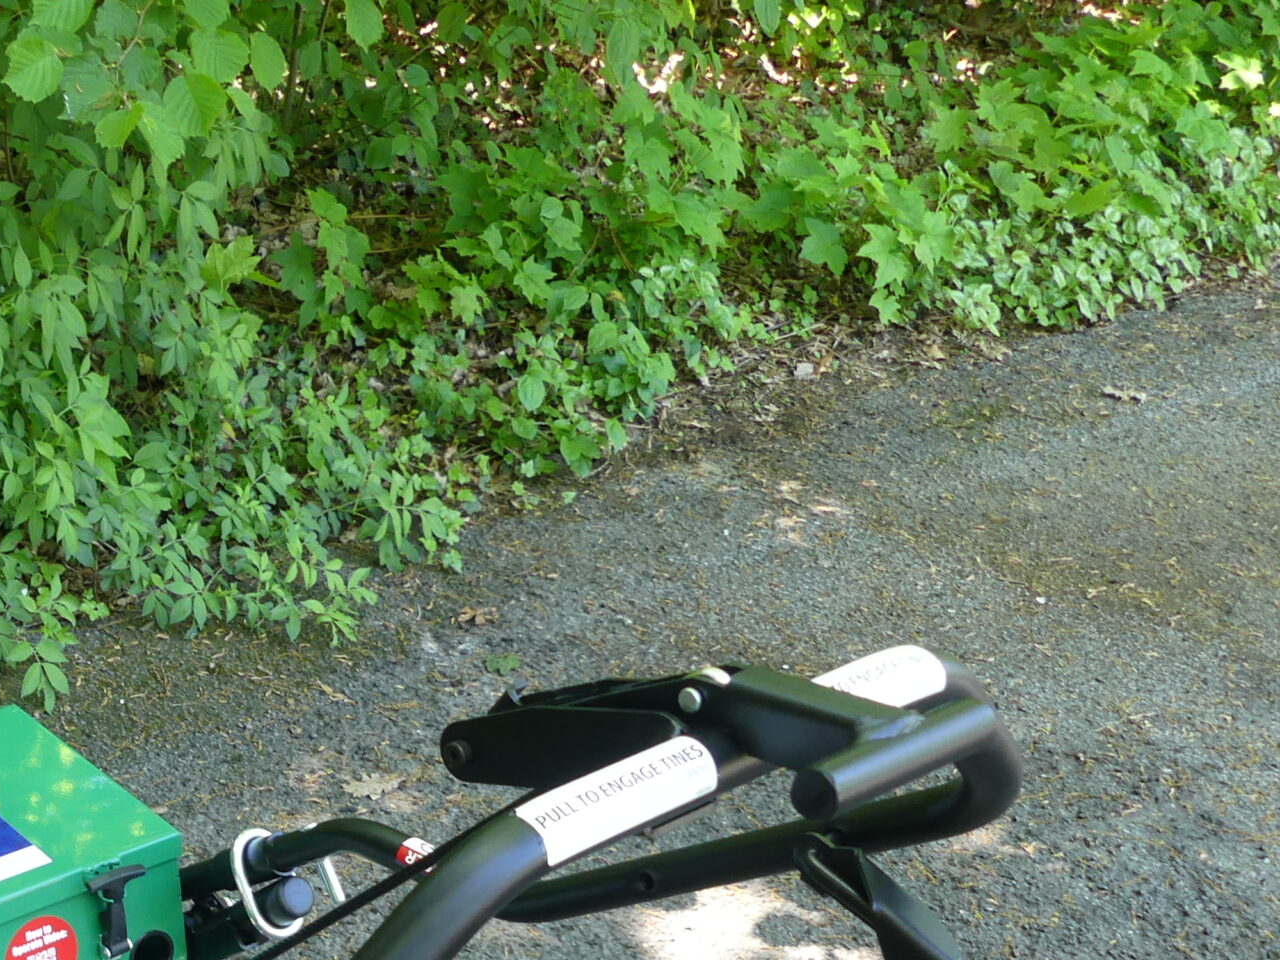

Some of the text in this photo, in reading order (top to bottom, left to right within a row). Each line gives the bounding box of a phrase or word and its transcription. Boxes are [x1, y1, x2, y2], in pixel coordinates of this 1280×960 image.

[535, 801, 580, 829] PULL
[576, 790, 601, 808] TO
[598, 763, 663, 798] ENGAGE
[660, 744, 705, 770] TINES
